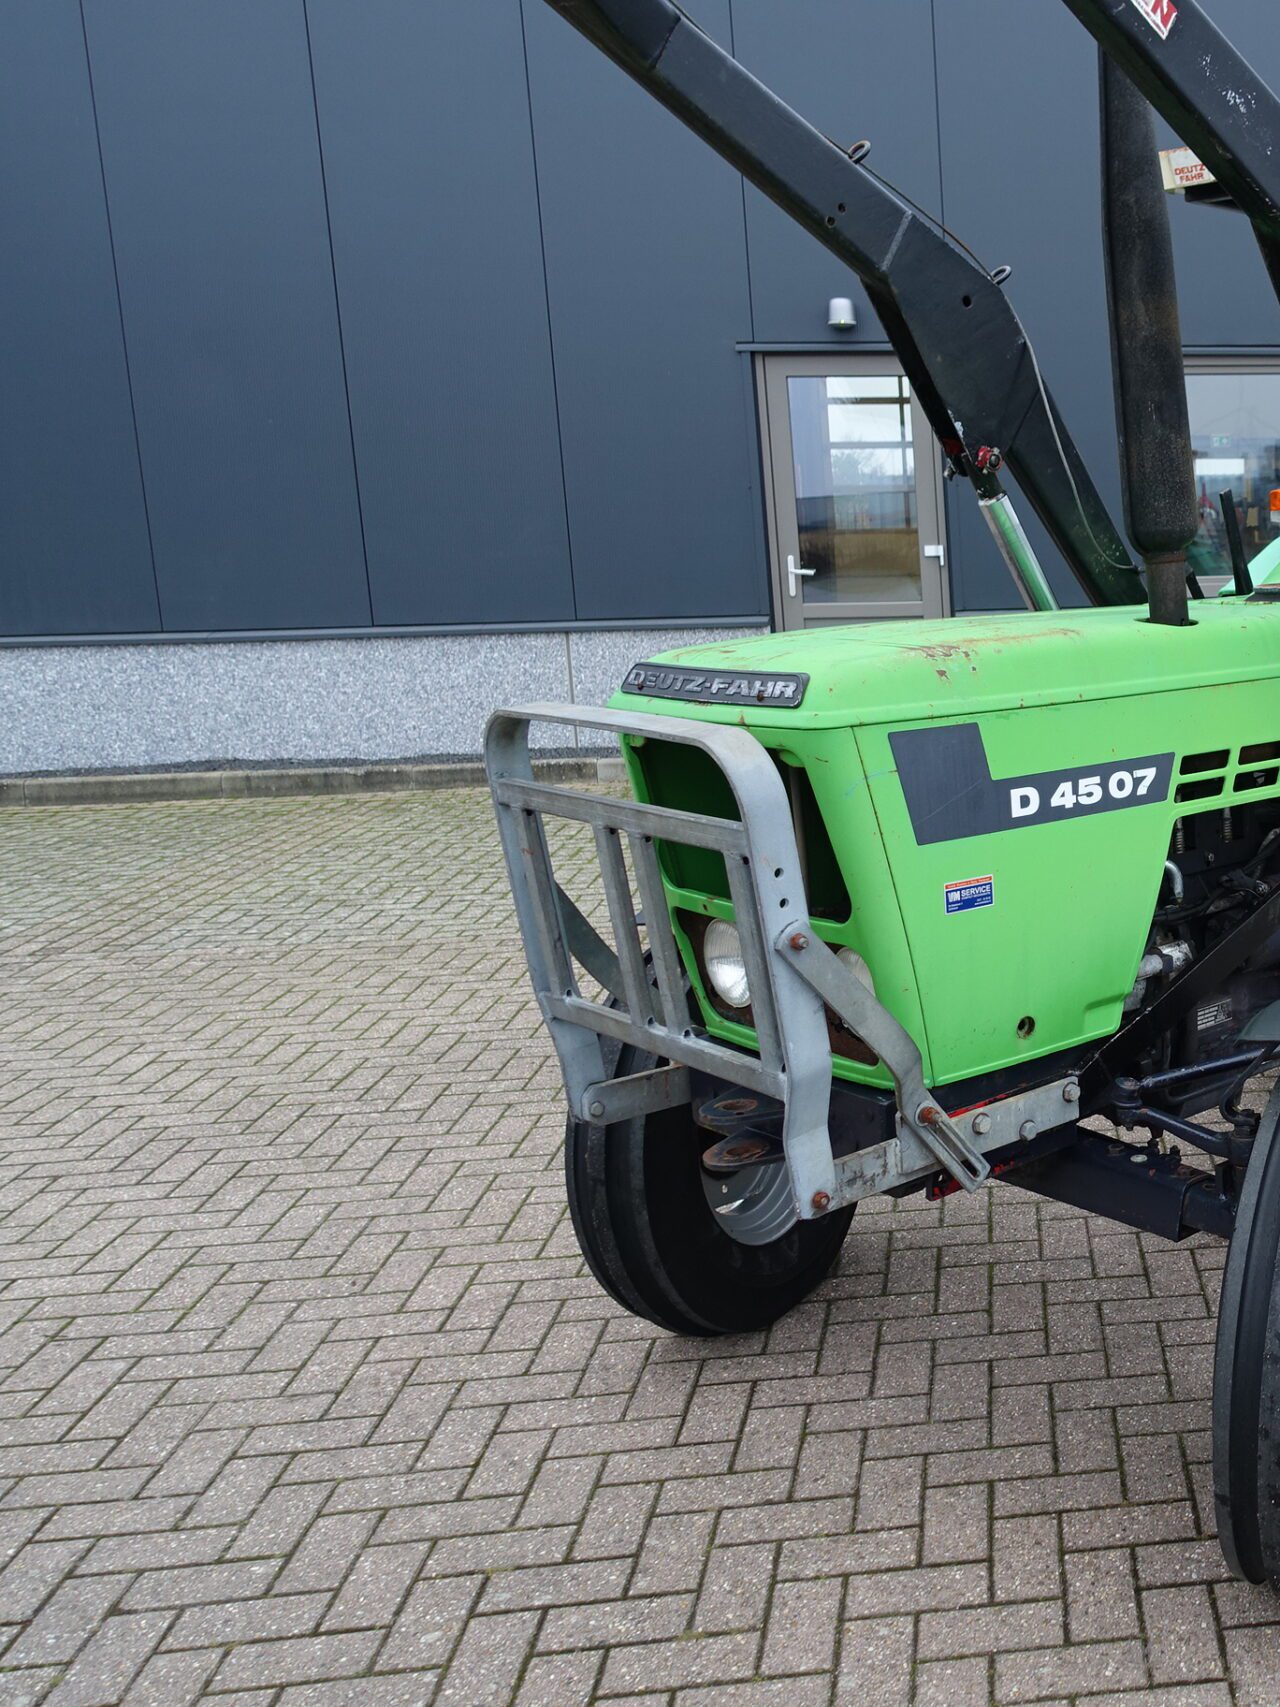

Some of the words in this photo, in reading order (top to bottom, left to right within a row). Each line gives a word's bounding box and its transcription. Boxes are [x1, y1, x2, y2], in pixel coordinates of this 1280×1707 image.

[1174, 164, 1206, 176] DEUTZ
[1179, 173, 1204, 182] FAHR
[627, 669, 797, 698] DEUTZ-FAHR
[1010, 786, 1040, 818] D
[961, 885, 991, 897] SERVICE
